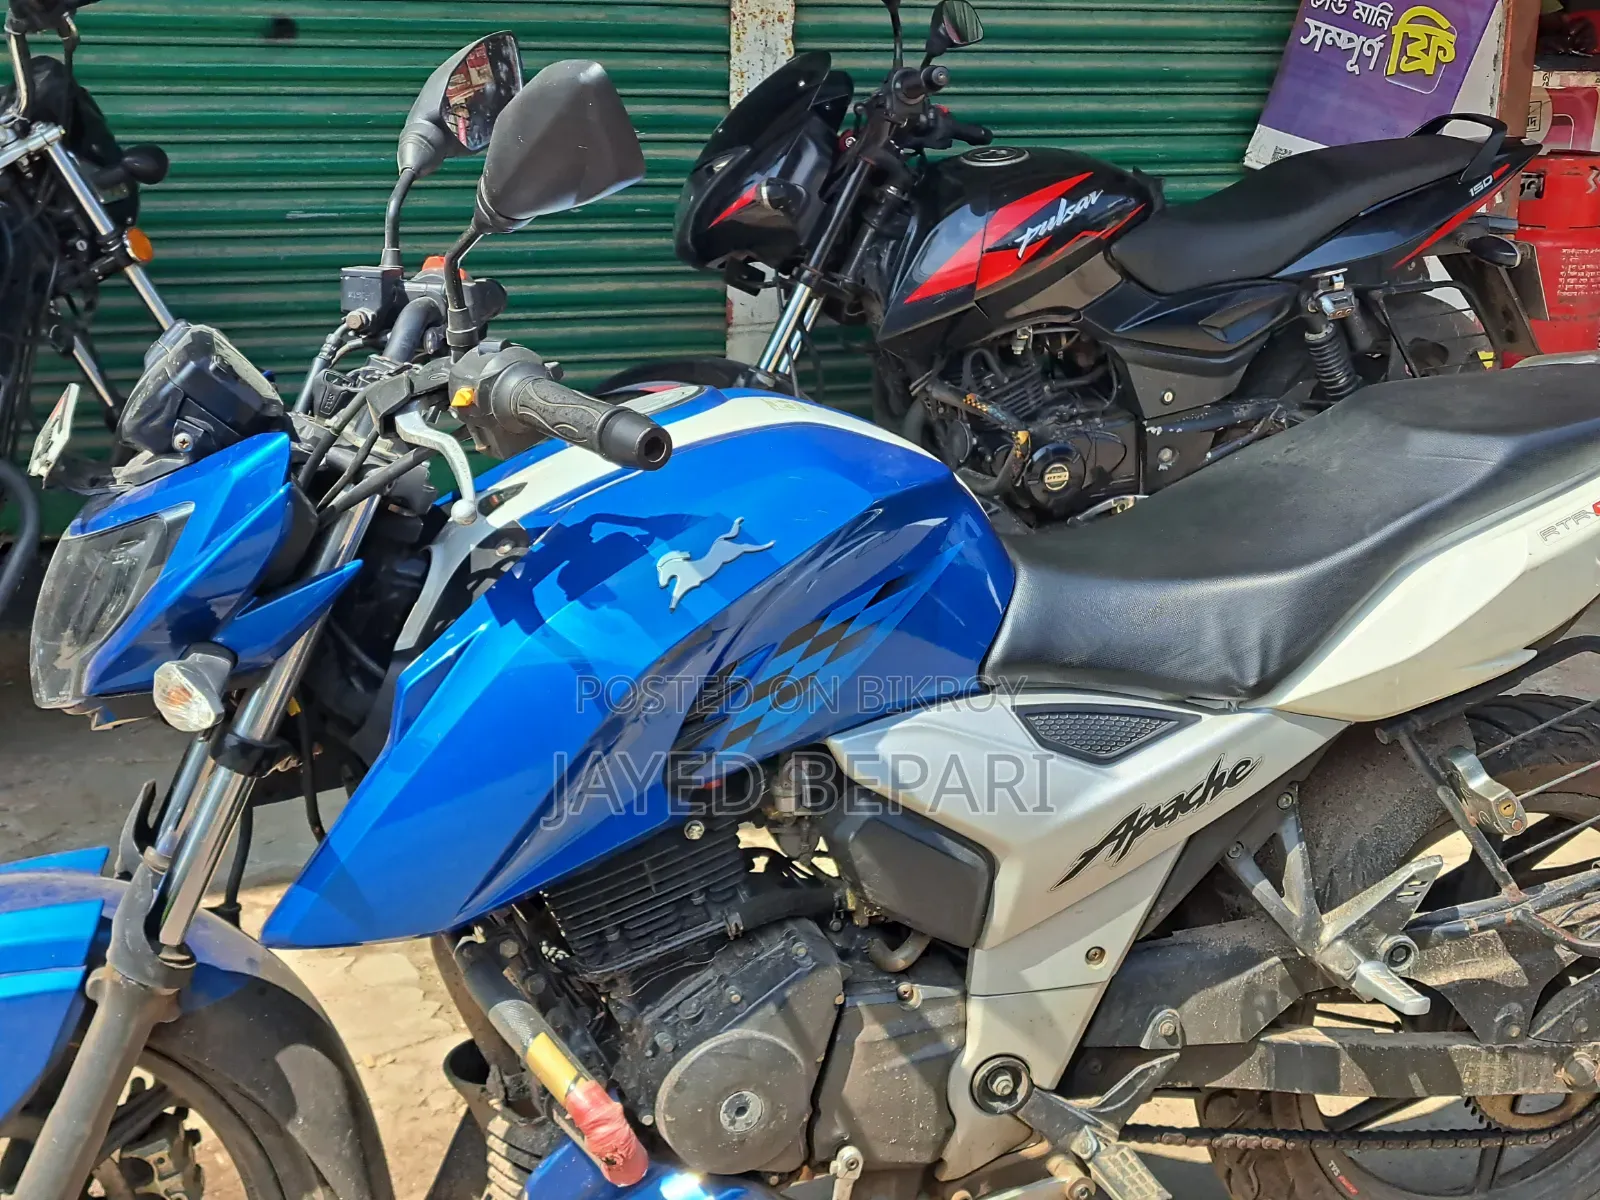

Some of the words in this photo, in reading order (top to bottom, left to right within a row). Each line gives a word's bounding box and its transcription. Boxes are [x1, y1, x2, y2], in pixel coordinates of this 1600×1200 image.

[1352, 1, 1394, 30] মানি
[1300, 17, 1387, 75] সম্পূর্ণ
[1387, 5, 1456, 75] ফ্রি
[1469, 174, 1494, 197] 150
[1539, 509, 1592, 542] RTR
[1050, 753, 1263, 892] Apache
